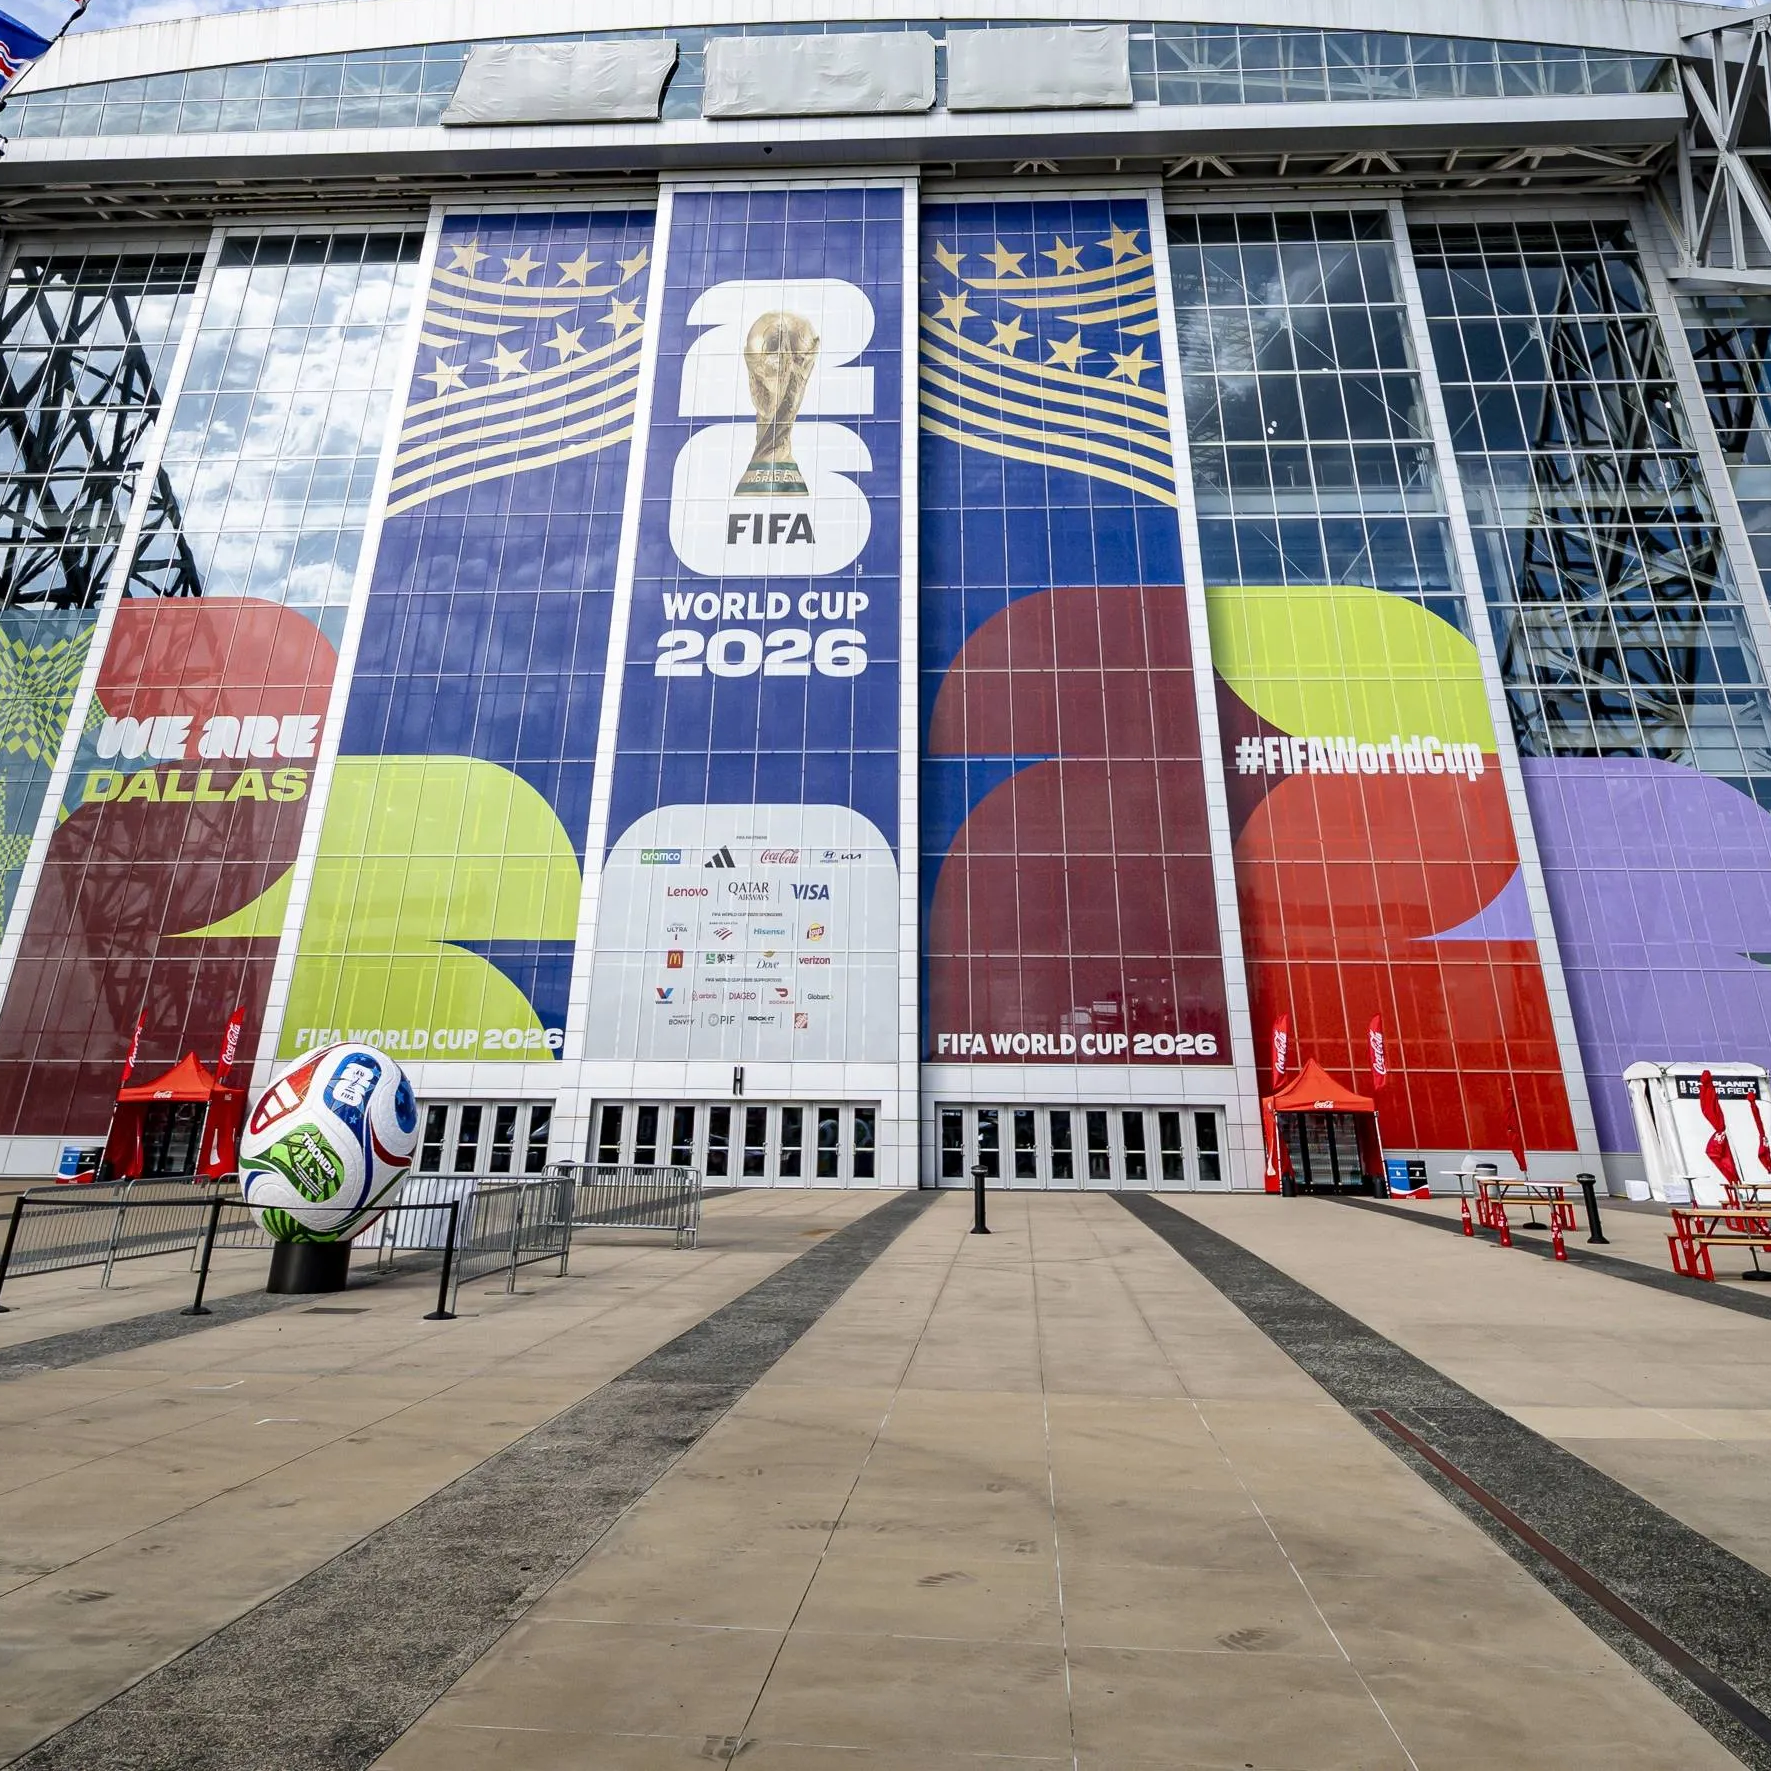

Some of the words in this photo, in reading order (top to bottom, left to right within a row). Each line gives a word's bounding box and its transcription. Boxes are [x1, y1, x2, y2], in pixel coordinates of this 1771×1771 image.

[727, 513, 816, 545] FIFA
[662, 591, 791, 621] WORLD
[798, 591, 870, 620] CUP
[654, 628, 869, 678] 2026
[96, 715, 194, 760] WE
[198, 714, 322, 759] ARE
[1235, 734, 1485, 782] #FIFAWorldCup
[81, 767, 308, 803] DALLAS
[641, 851, 681, 862] aramco
[667, 886, 709, 897] Lenovo
[728, 881, 769, 895] QATAR
[738, 893, 770, 901] AIRWAYS
[790, 883, 830, 900] VISA
[753, 928, 786, 936] Hisense
[756, 959, 780, 969] Dove
[798, 955, 831, 965] verizon
[728, 992, 757, 1000] DIAGEO
[720, 1015, 736, 1025] PIF
[295, 1028, 342, 1049] FIFA
[345, 1028, 428, 1050] WORLD
[432, 1028, 478, 1050] CUP
[482, 1028, 564, 1050] 2026
[937, 1033, 987, 1055] FIFA
[990, 1033, 1077, 1055] WORLD
[1080, 1033, 1128, 1055] CUP
[1133, 1033, 1217, 1056] 2026
[732, 1066, 744, 1096] H
[301, 1131, 337, 1179] TRIONDA
